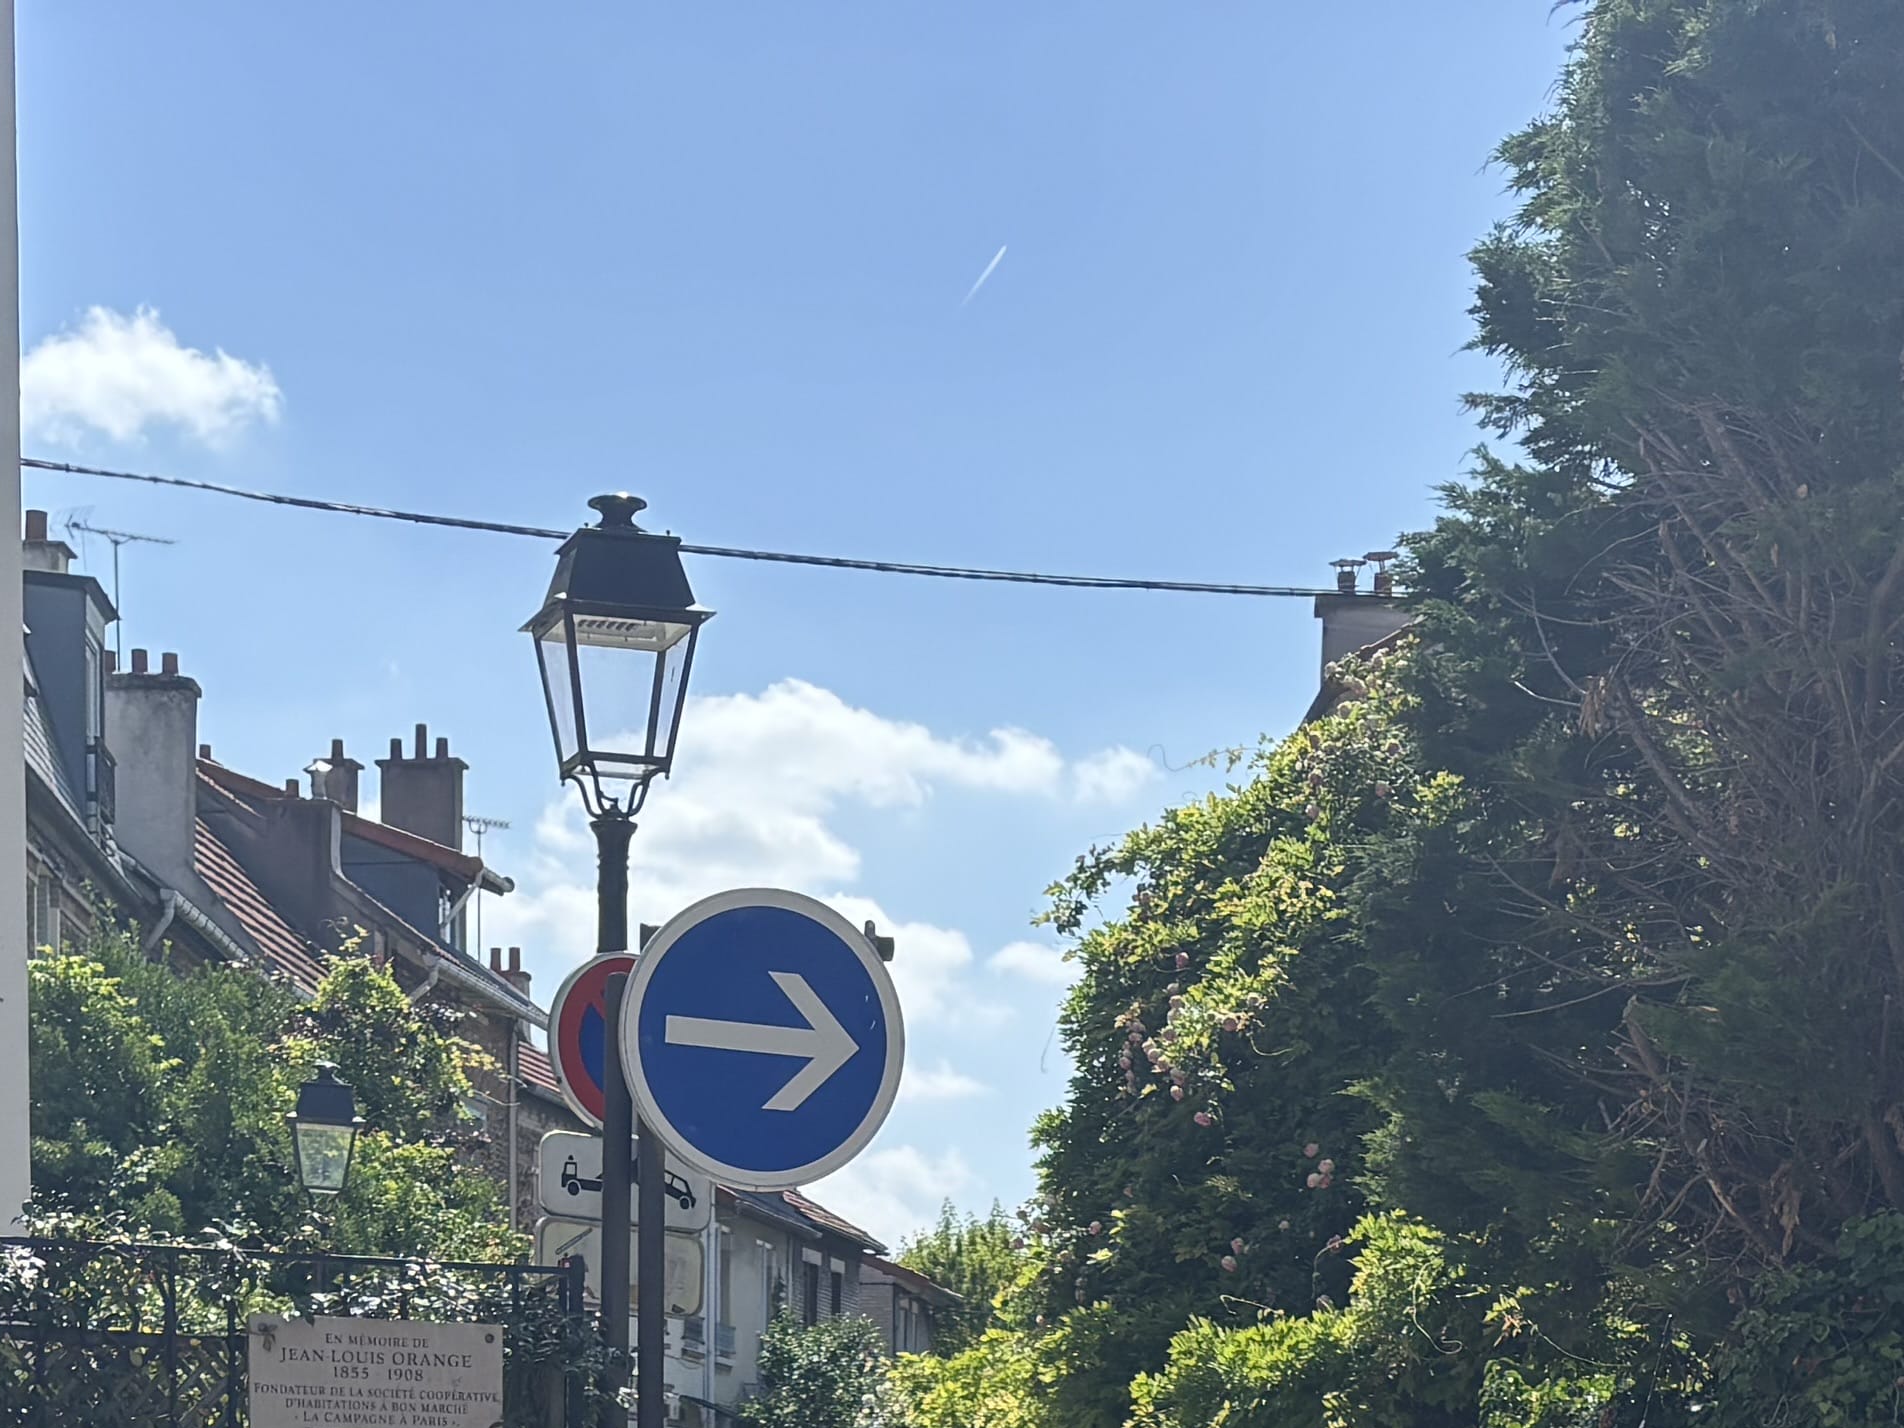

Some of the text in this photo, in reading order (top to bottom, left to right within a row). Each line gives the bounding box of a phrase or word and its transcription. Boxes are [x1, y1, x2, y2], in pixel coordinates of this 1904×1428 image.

[325, 1332, 430, 1349] EN MÉMOIRE DE
[279, 1346, 473, 1368] JEAN-LOUIS ORANGE
[333, 1365, 425, 1382] 1855 1908
[254, 1382, 326, 1396] FONDATEUR
[329, 1386, 347, 1397] DE
[349, 1387, 365, 1398] LA
[391, 1402, 417, 1412] BON
[303, 1411, 320, 1423] LA
[323, 1412, 396, 1426] CAMPAGNE
